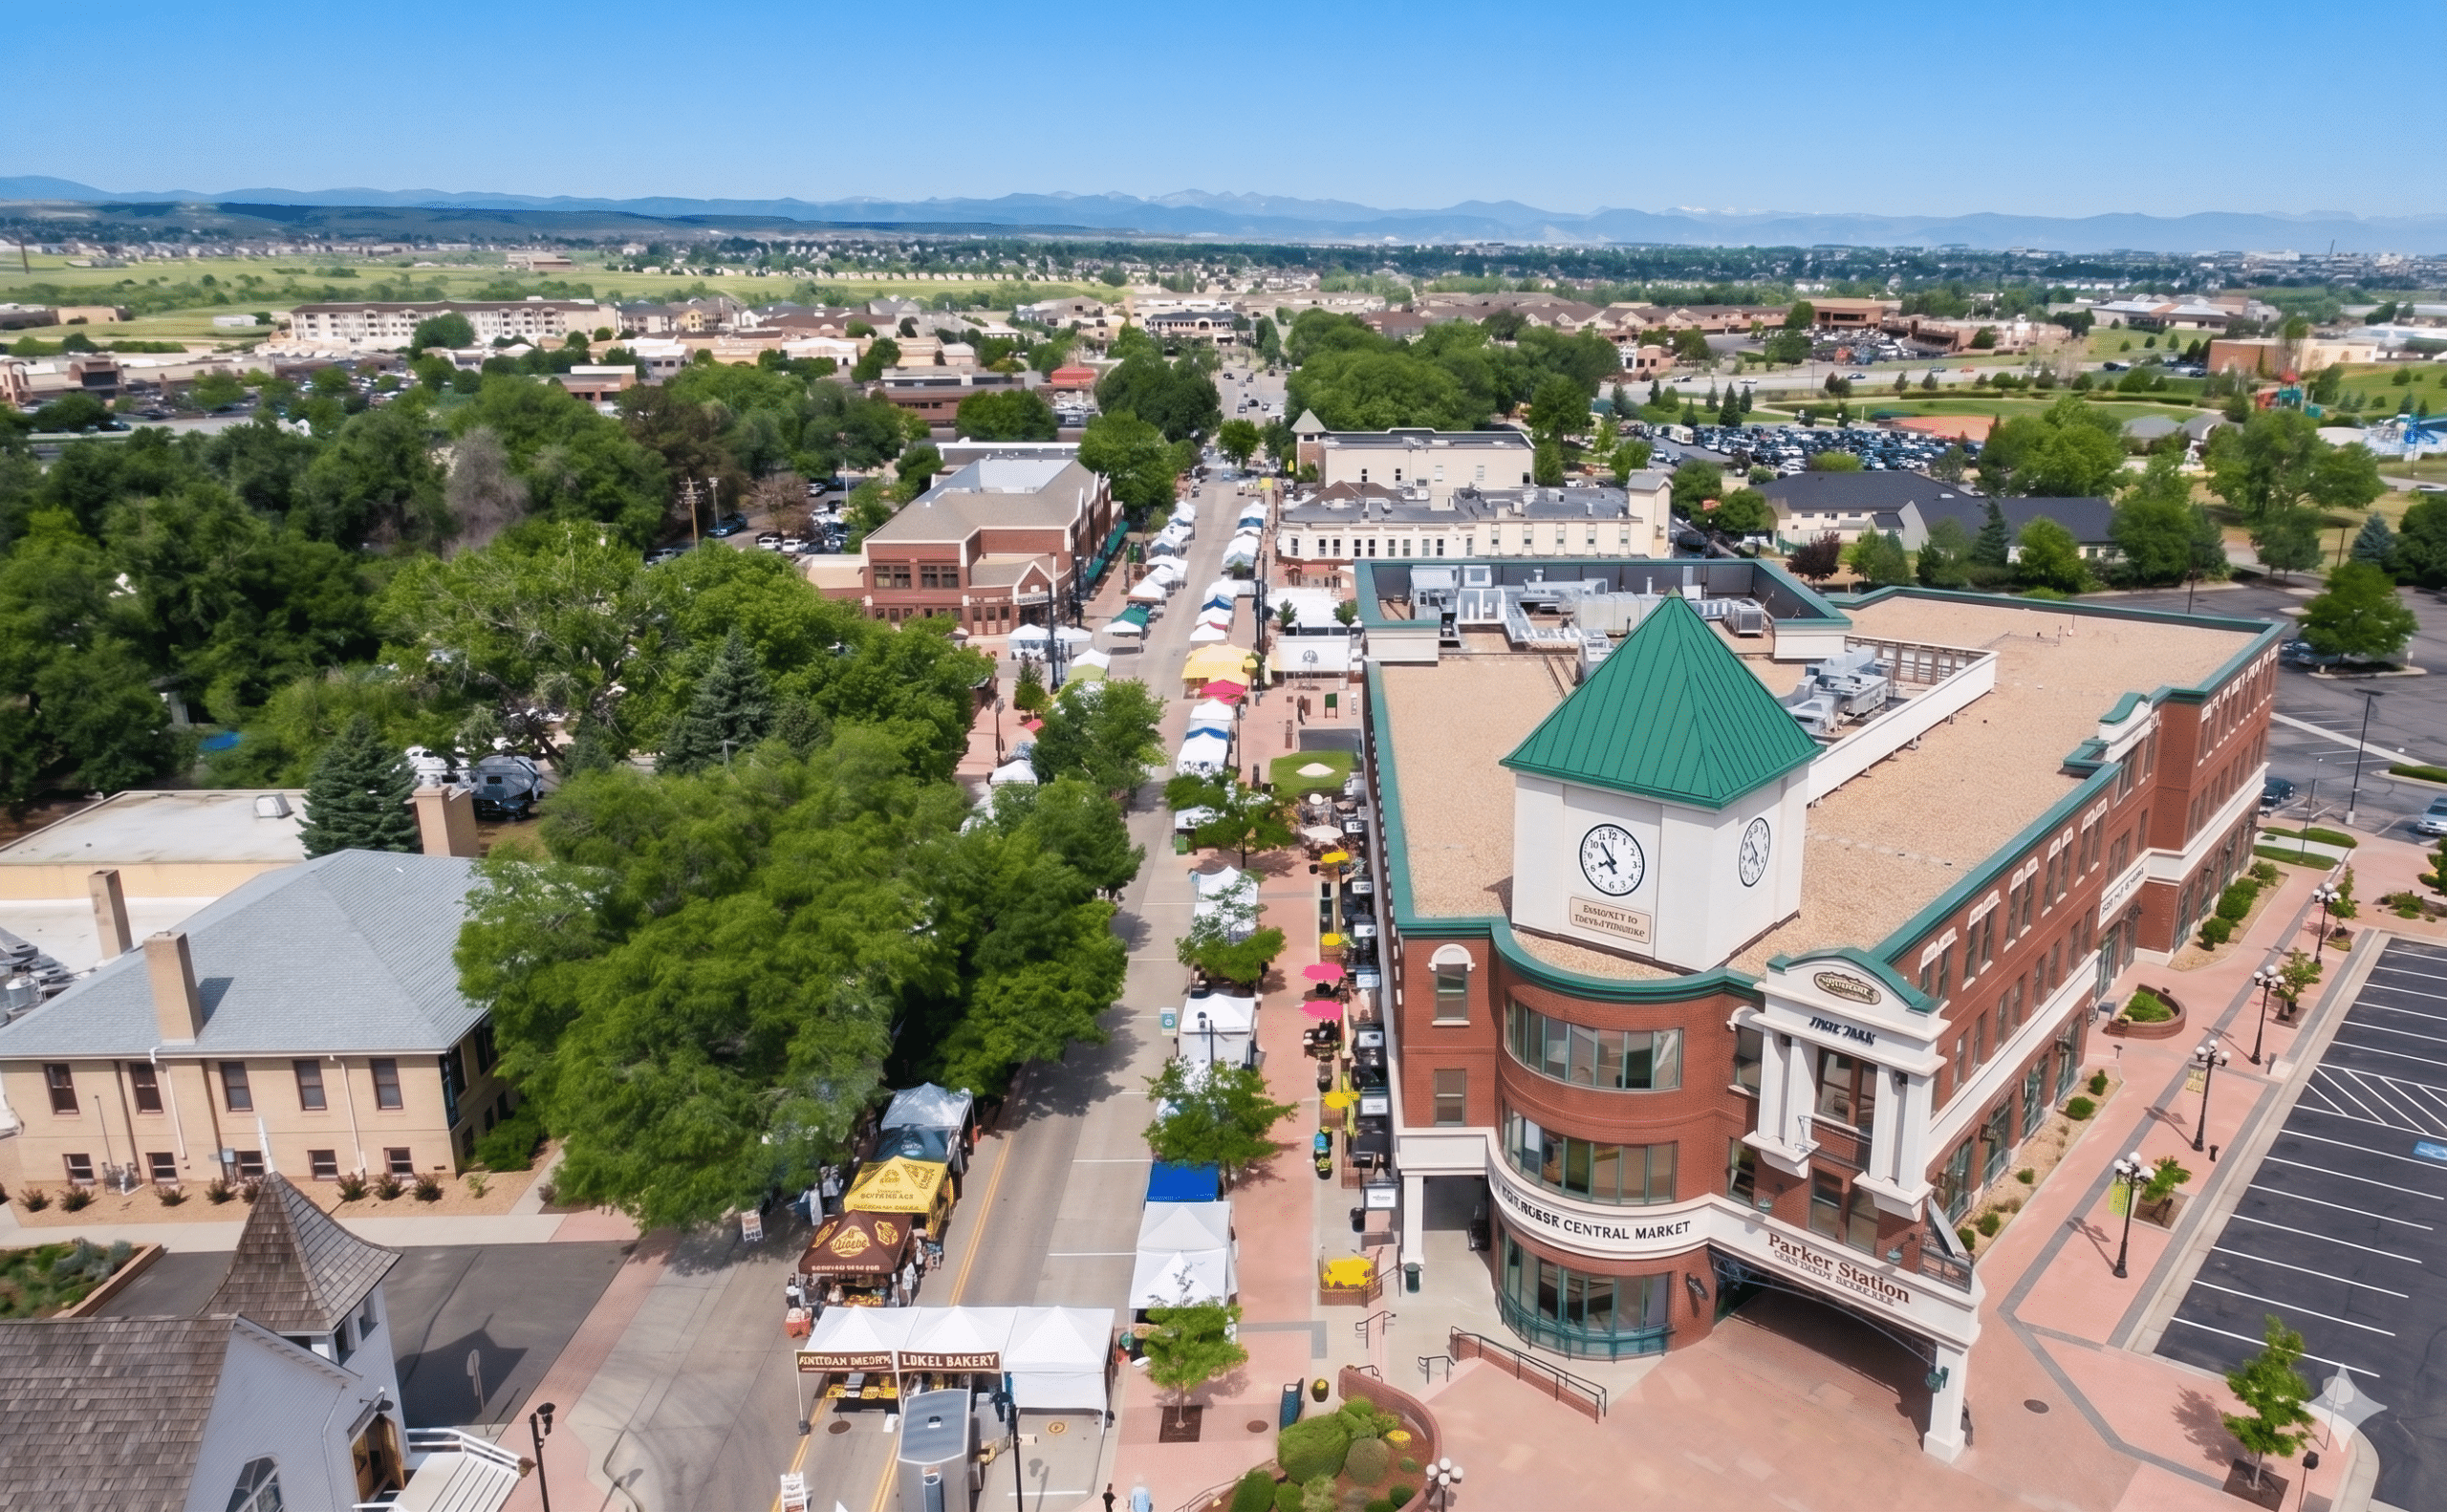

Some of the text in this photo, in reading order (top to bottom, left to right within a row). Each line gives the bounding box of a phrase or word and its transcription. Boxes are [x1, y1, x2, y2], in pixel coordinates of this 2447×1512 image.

[1609, 832, 1617, 841] 12
[1590, 840, 1599, 849] 10
[1630, 848, 1635, 856] 2
[1632, 860, 1637, 869] 3
[1598, 875, 1604, 883] 7
[1628, 873, 1634, 881] 4
[1563, 1219, 1630, 1240] CENTRAL
[1635, 1220, 1691, 1240] MARKET
[1768, 1232, 1833, 1271] Parker
[1838, 1262, 1910, 1304] Station
[945, 1353, 997, 1368] BAKERY
